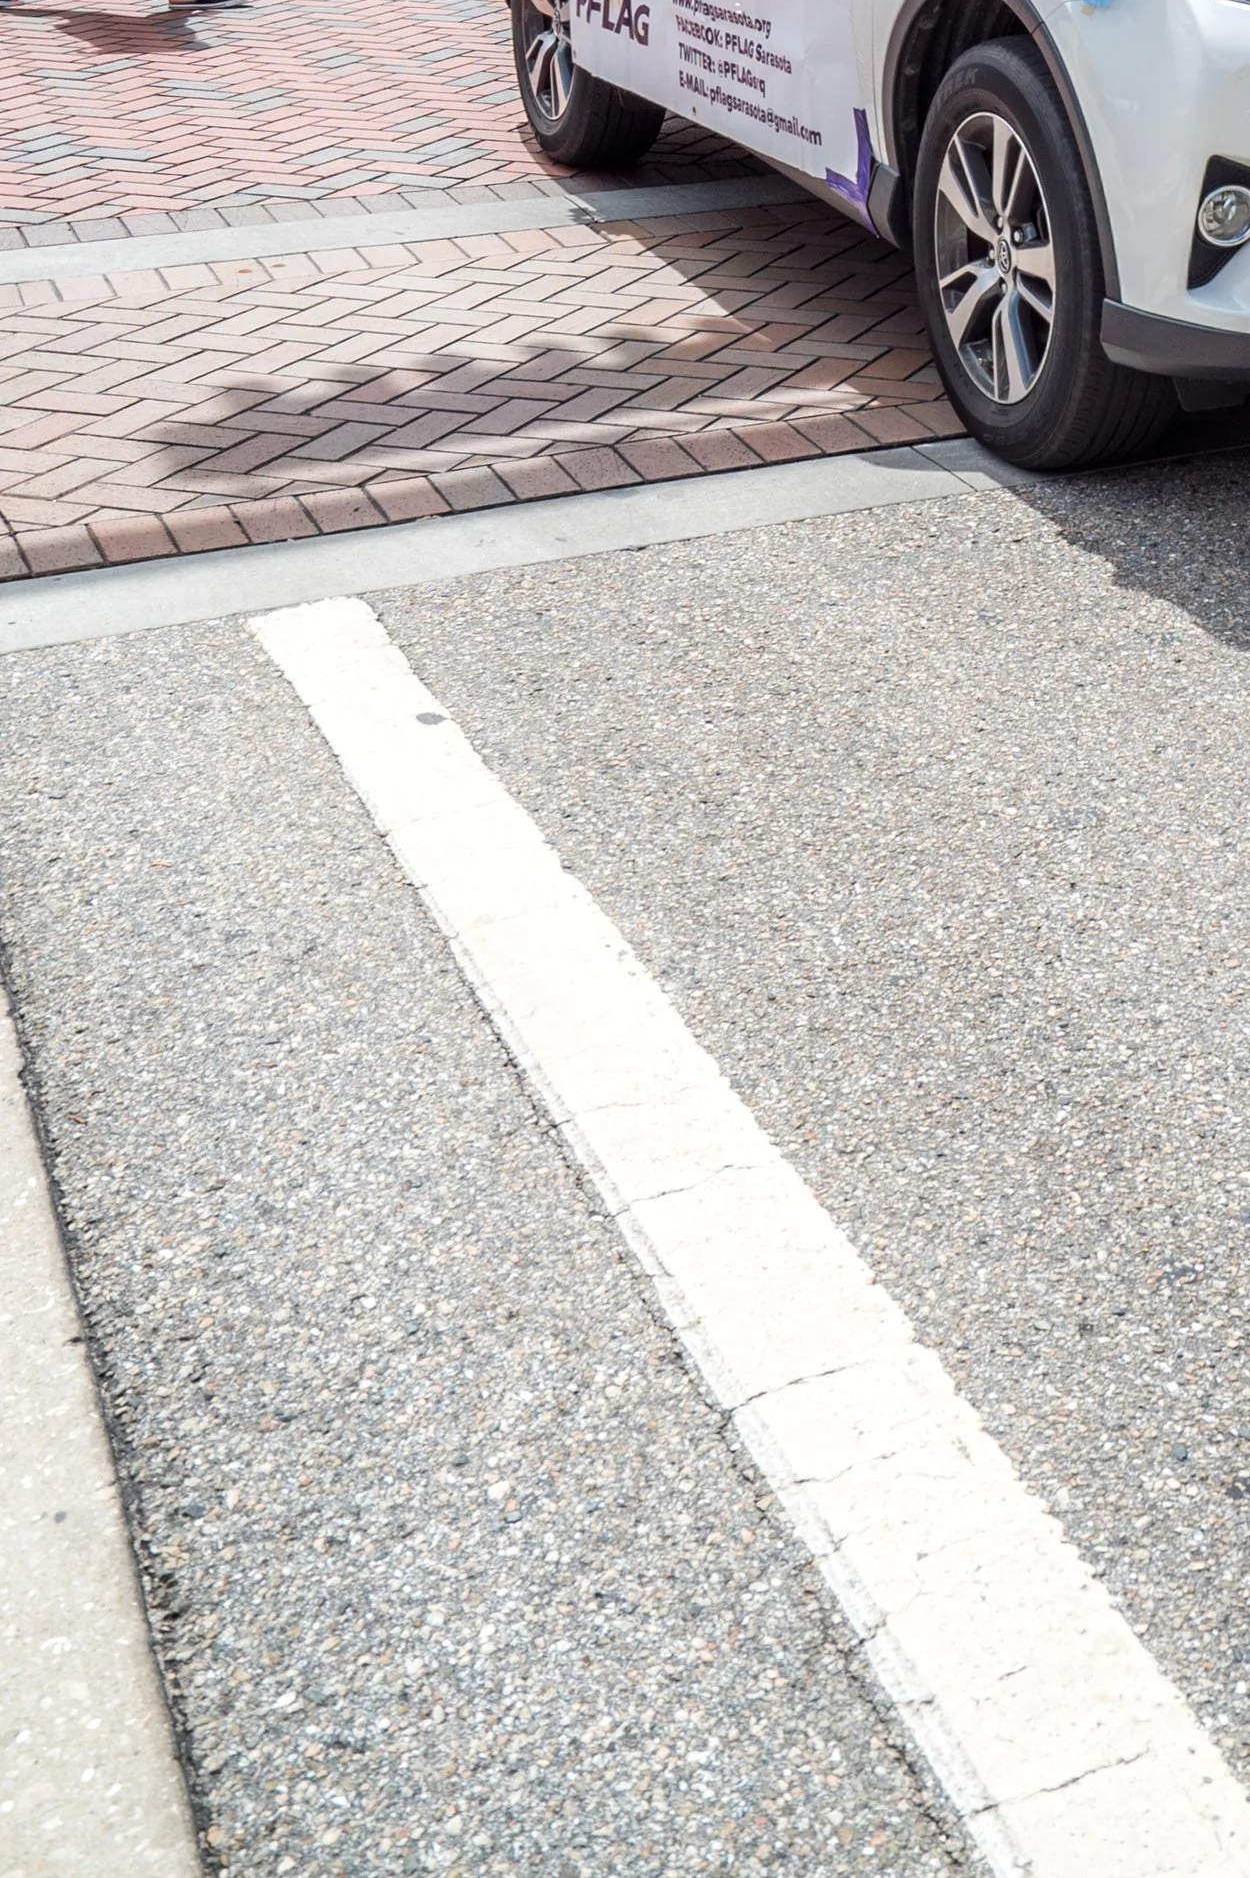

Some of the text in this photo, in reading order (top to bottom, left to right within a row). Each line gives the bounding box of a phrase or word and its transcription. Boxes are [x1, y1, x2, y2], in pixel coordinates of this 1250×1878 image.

[678, 42, 716, 74] TWITTER:
[725, 32, 754, 59] PFLAG
[755, 43, 792, 75] Sarasota
[679, 70, 709, 98] E-MAIL:
